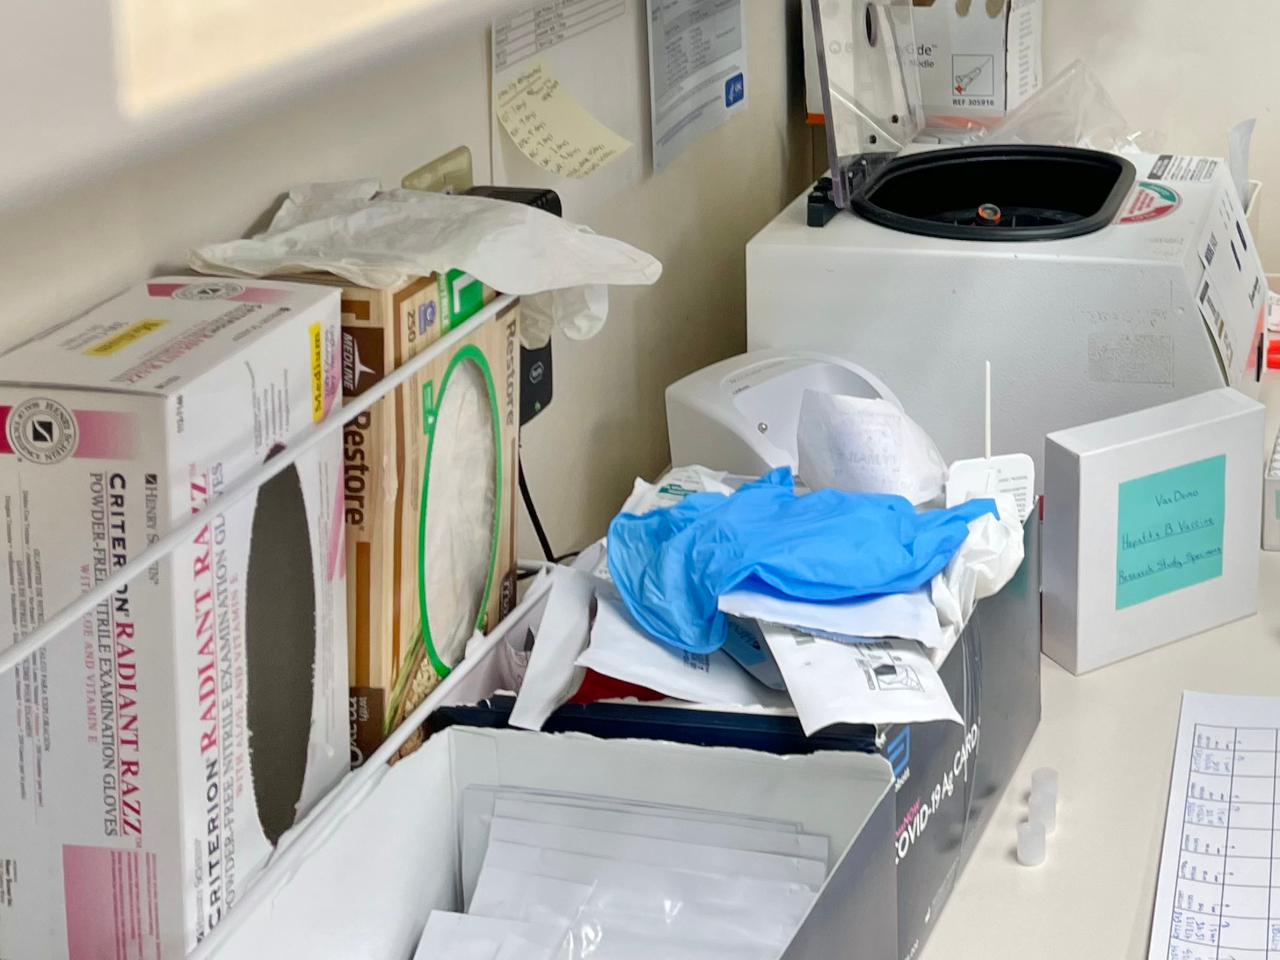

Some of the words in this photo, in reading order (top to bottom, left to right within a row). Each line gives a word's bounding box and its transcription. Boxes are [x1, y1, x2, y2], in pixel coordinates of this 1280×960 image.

[343, 332, 356, 390] MEDLINE
[407, 309, 416, 343] 250
[313, 331, 322, 413] Medium
[506, 320, 518, 426] Restore
[344, 410, 371, 525] Restore
[145, 484, 158, 530] HENRY
[1165, 523, 1173, 536] B
[1119, 563, 1155, 583] Research
[84, 641, 95, 669] AND
[215, 551, 233, 691] EXAMINATION
[85, 674, 97, 732] VITAMIN
[116, 622, 140, 752] RADIANT
[194, 590, 218, 756] RADIANT
[98, 658, 116, 769] EXAMINATION
[220, 694, 234, 772] NITRILE
[102, 773, 118, 837] GLOVES
[120, 757, 143, 836] RAZZ
[895, 783, 941, 865] OVID-19
[942, 771, 954, 797] Ag
[954, 723, 978, 776] CARD
